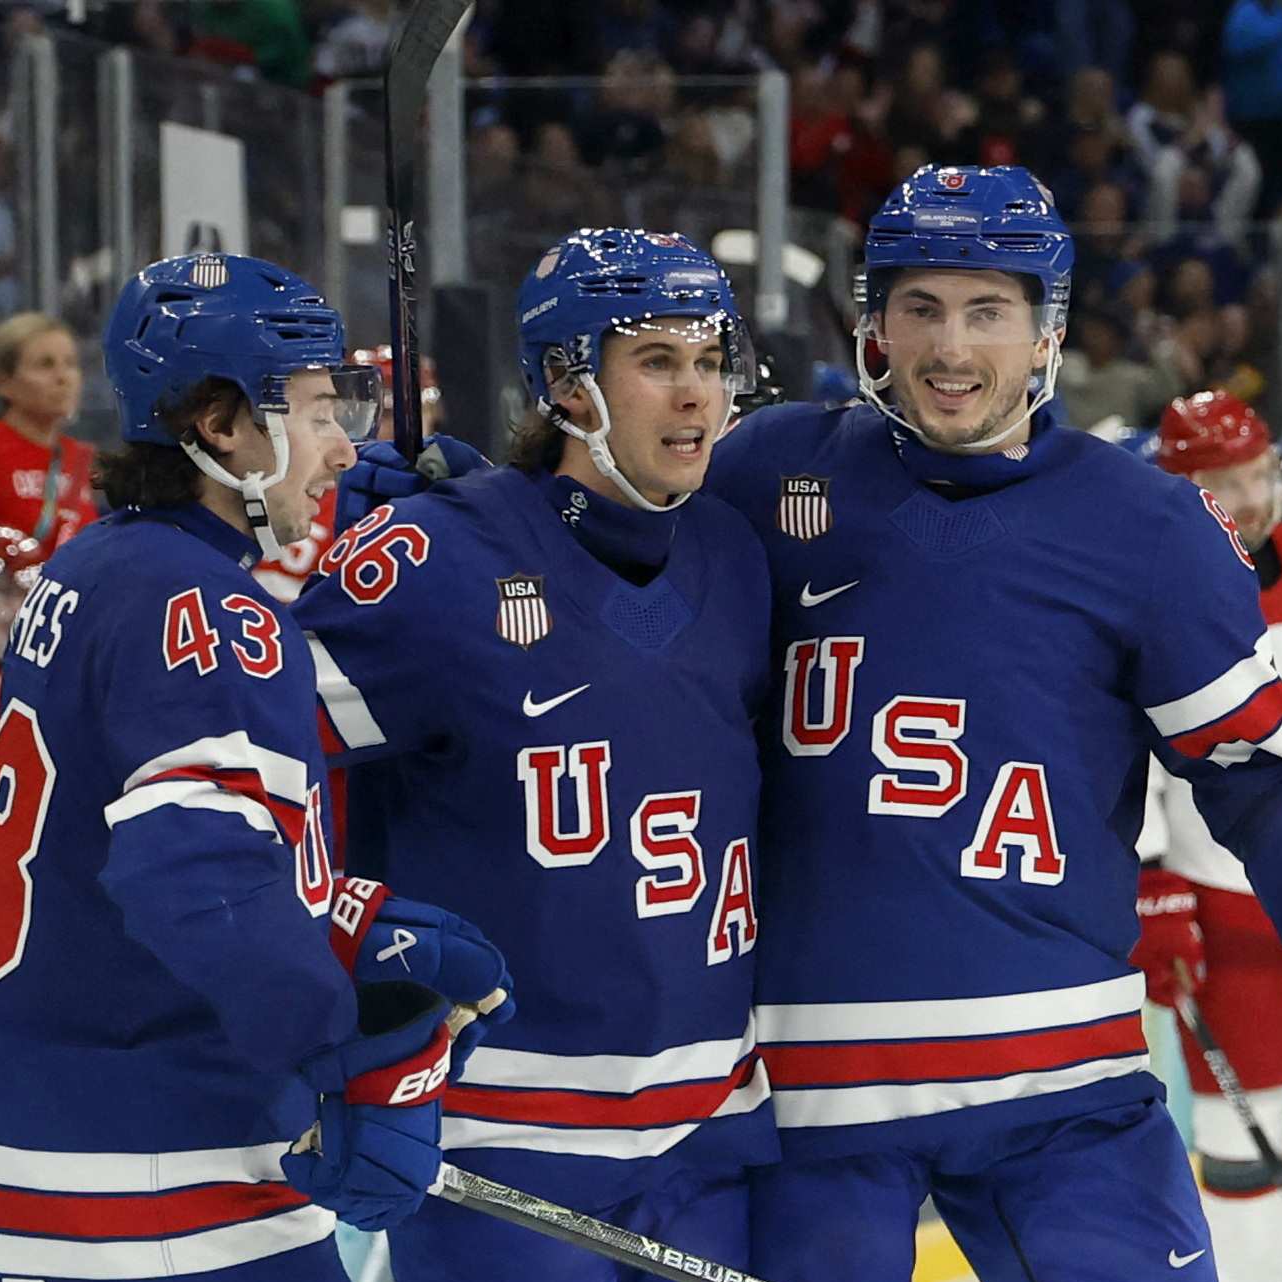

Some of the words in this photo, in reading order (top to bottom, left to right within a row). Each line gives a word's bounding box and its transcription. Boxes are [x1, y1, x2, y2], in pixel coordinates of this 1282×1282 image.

[788, 480, 821, 493] USA
[319, 504, 430, 605] 86
[504, 581, 537, 597] USA
[9, 576, 80, 669] HES
[163, 587, 283, 679] 43
[783, 636, 1065, 886] USA
[516, 739, 758, 966] USA
